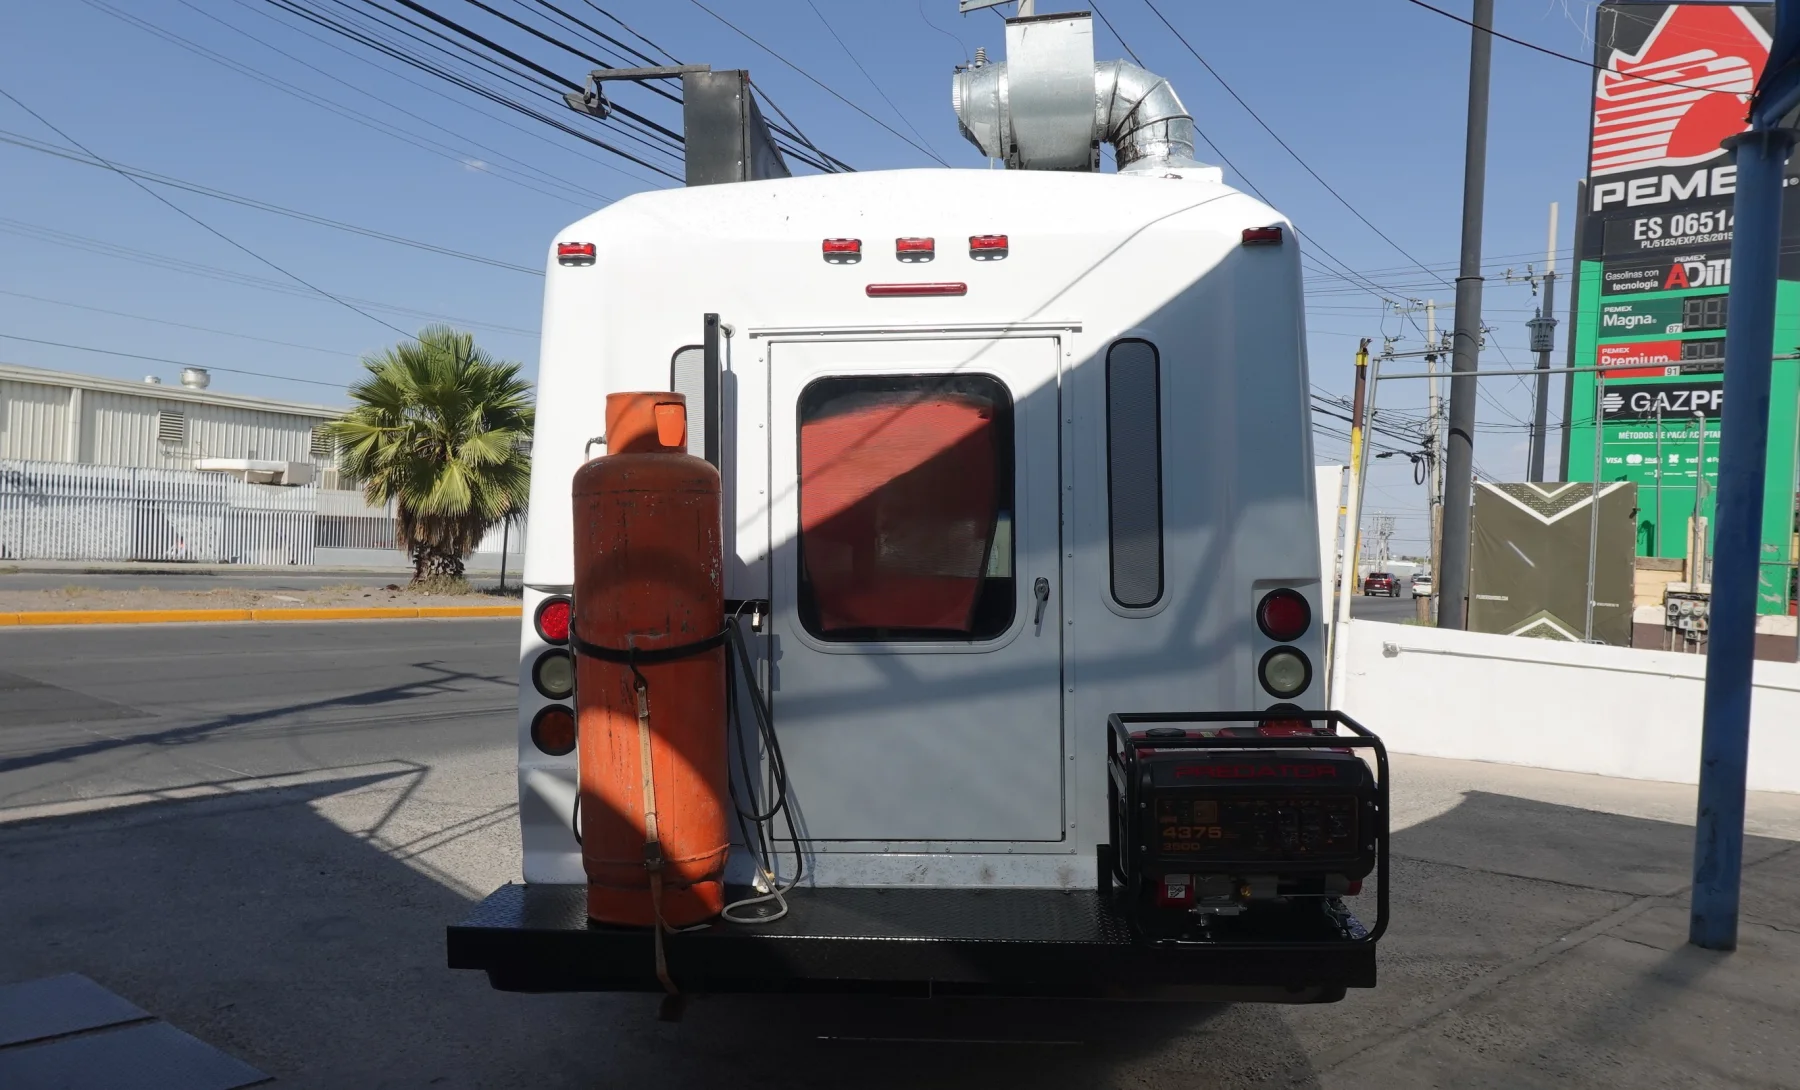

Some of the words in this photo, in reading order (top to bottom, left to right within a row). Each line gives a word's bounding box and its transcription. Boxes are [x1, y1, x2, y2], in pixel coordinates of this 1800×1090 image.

[1593, 159, 1789, 212] PEME
[1634, 217, 1663, 241] ES
[1674, 254, 1706, 263] PEMEX
[1605, 271, 1643, 281] Gasolinas
[1644, 269, 1659, 278] con
[1612, 279, 1659, 291] tecnología
[1604, 305, 1632, 313] PEMEX
[1603, 314, 1652, 329] Magna
[1668, 325, 1680, 334] 87
[1601, 353, 1668, 367] Premium
[1618, 430, 1654, 440] MÉTODOS
[1173, 764, 1337, 779] PREDATOR
[1162, 826, 1223, 839] 4375
